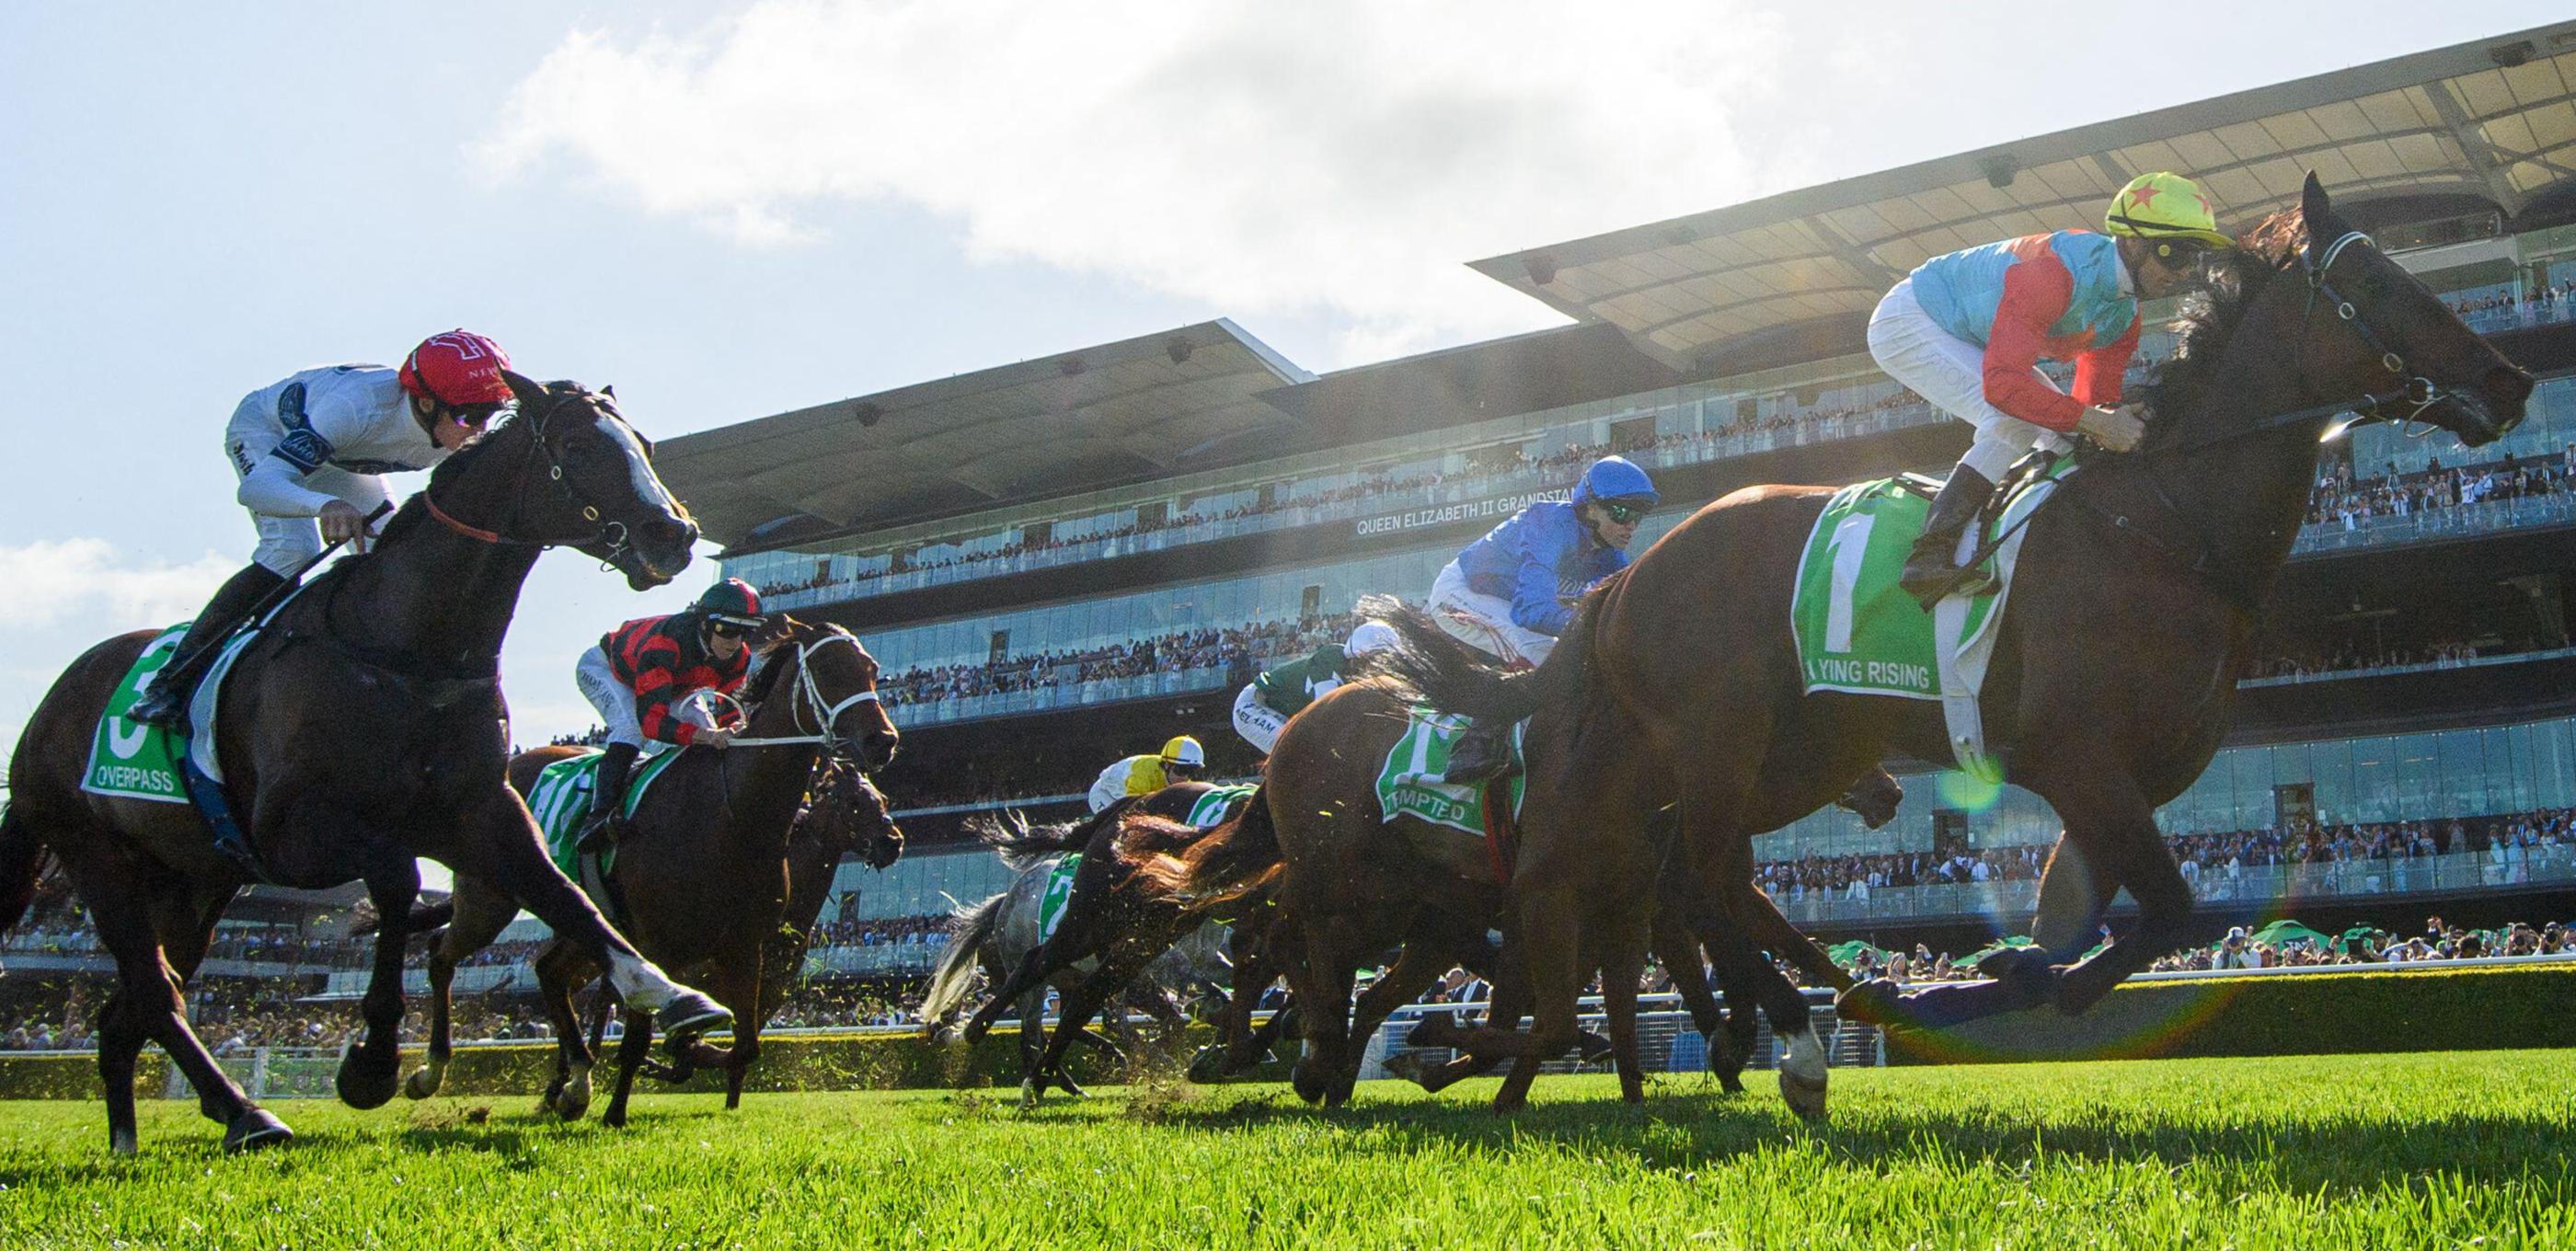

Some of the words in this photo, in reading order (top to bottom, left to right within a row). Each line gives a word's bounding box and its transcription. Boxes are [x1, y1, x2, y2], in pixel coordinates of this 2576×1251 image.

[1357, 515, 1401, 535] QUEEN
[1404, 502, 1478, 528] ELIZABETH
[1481, 499, 1494, 516] II
[1825, 511, 1876, 653] 1
[1818, 658, 1863, 683] YING
[1868, 661, 1930, 690] RISING
[109, 629, 190, 760] 3
[96, 765, 175, 793] OVERPASS
[1385, 788, 1466, 821] TEMPTED
